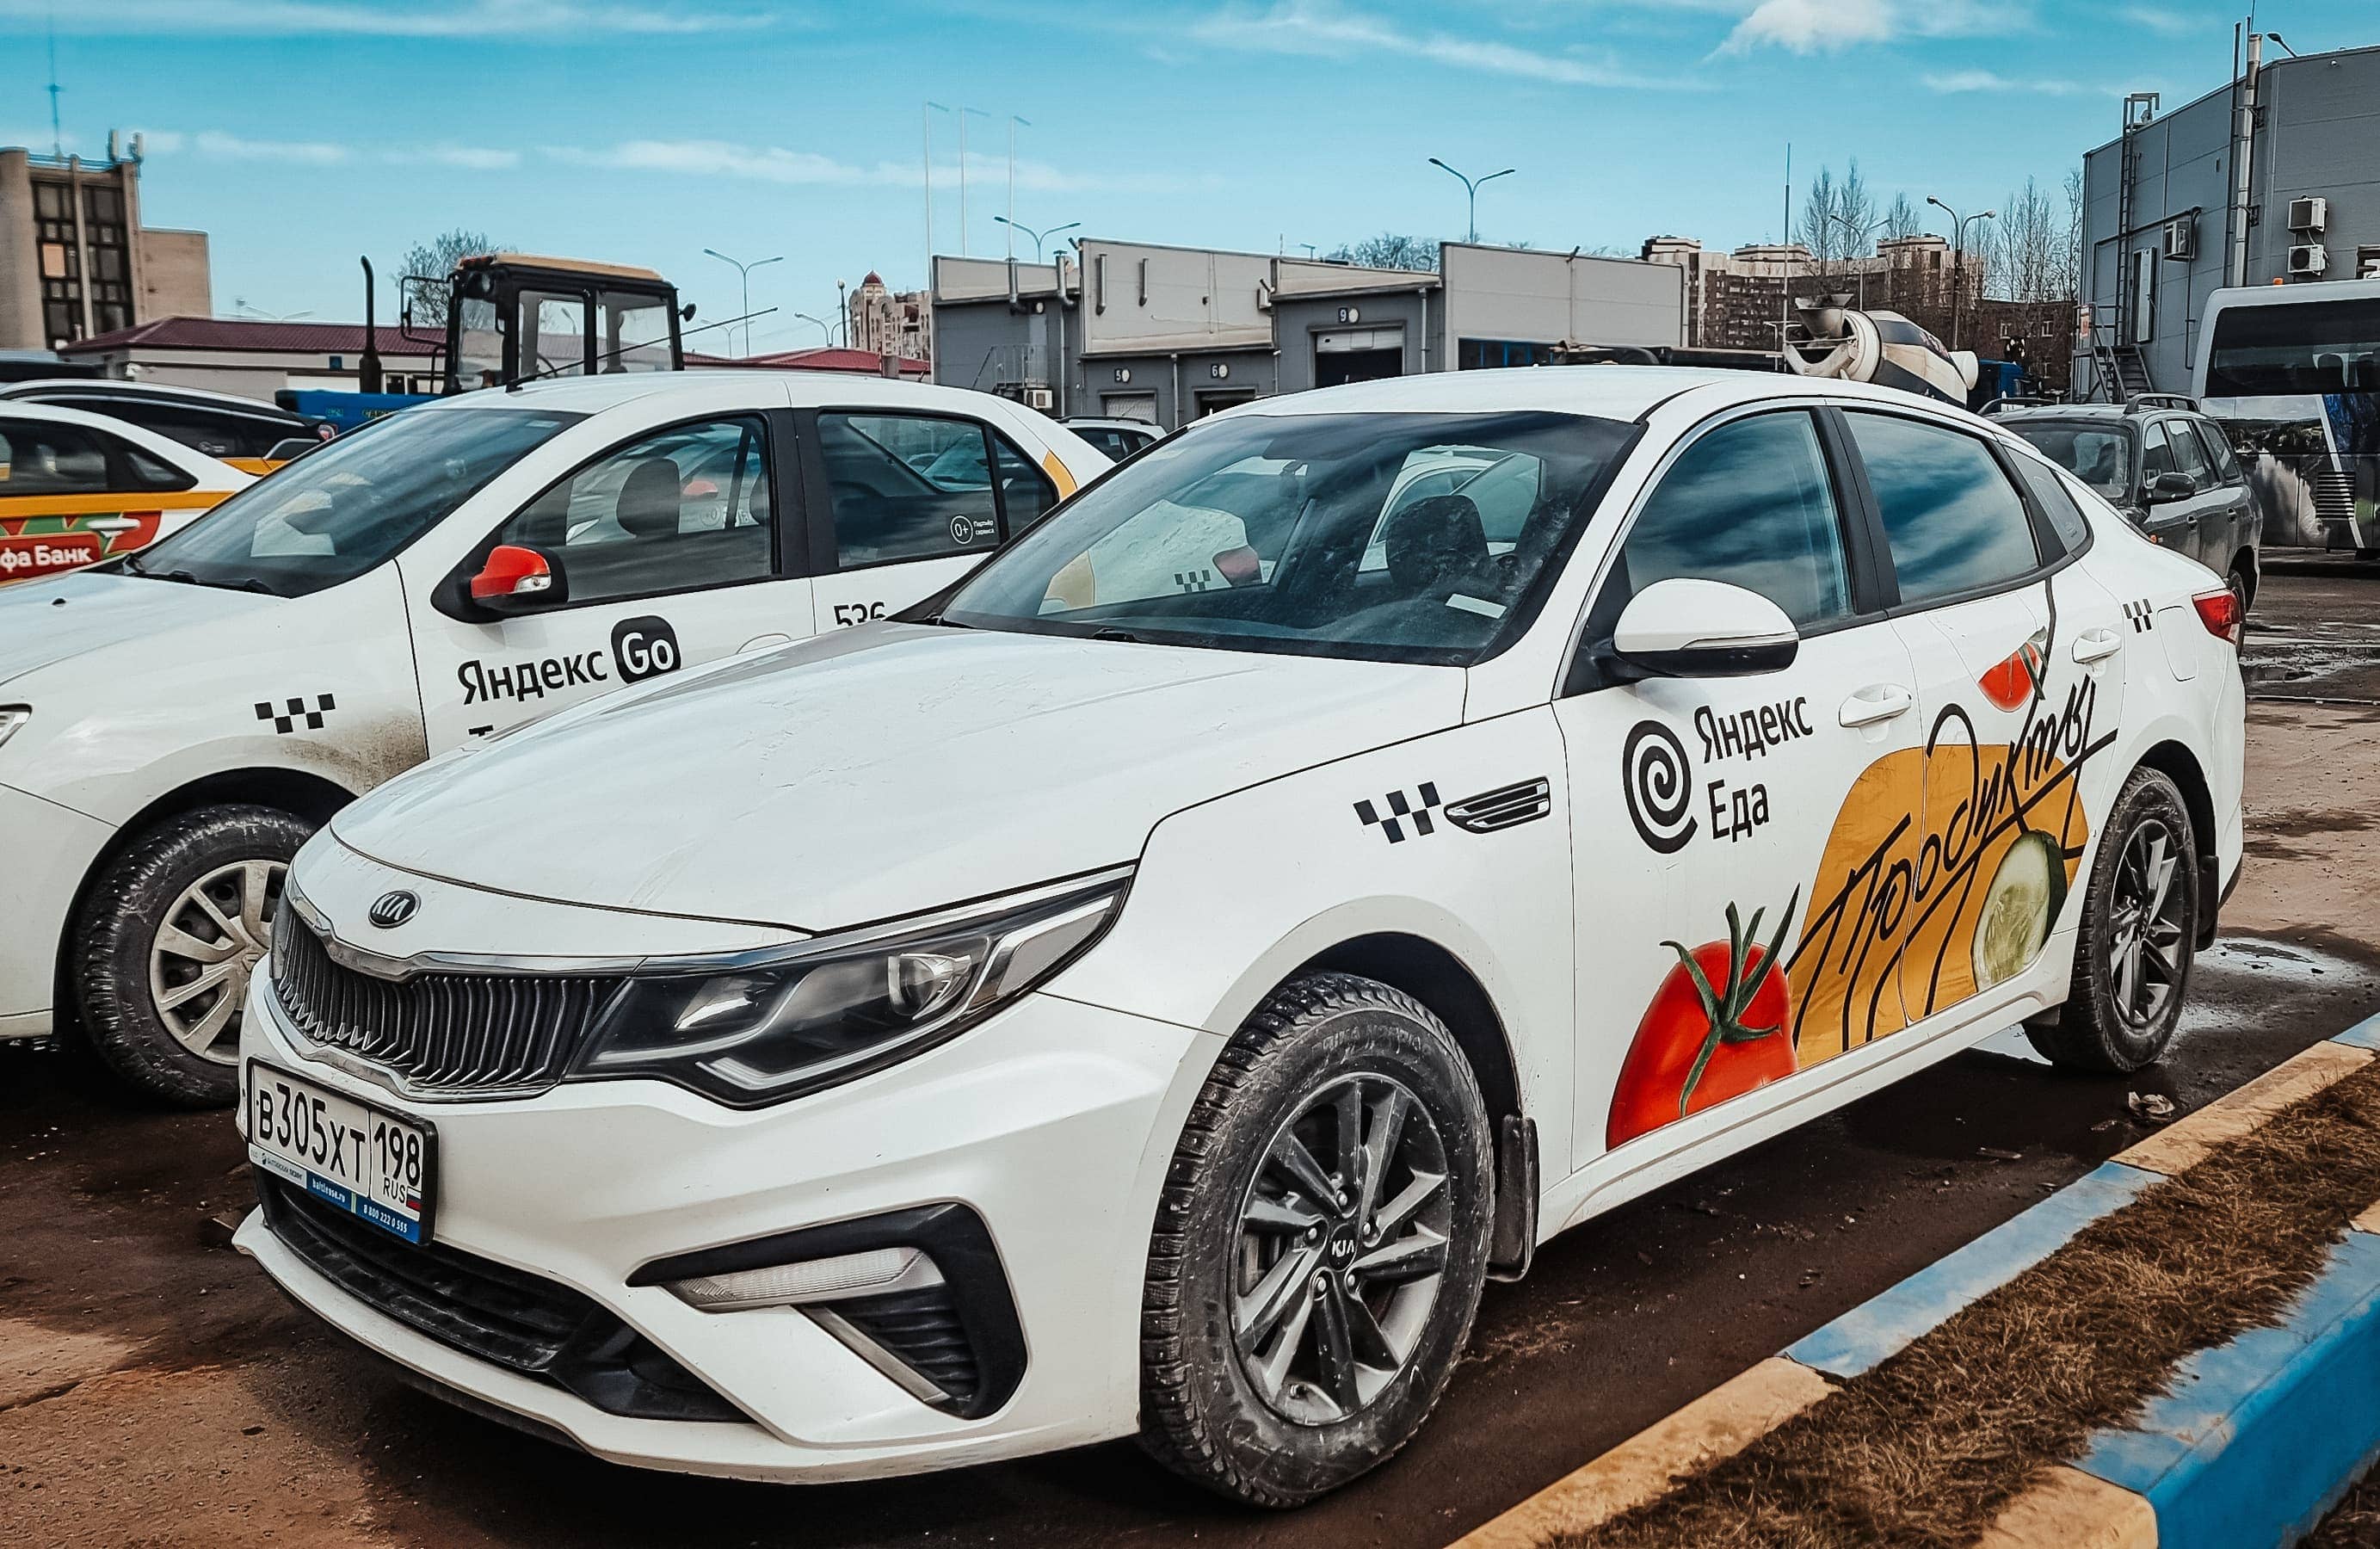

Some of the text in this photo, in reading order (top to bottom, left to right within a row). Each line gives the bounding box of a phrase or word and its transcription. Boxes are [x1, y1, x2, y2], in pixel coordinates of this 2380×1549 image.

[1340, 309, 1347, 322] 9
[1116, 370, 1122, 381] 5
[1212, 365, 1218, 376] 6
[954, 523, 969, 537] 0+
[34, 545, 95, 567] Банк
[457, 632, 675, 706] Яндекс Go
[1693, 694, 1815, 765] Яндекс
[1709, 779, 1771, 843] Еда
[1784, 675, 2118, 1052] Продукты
[371, 893, 410, 921] KIA
[259, 1081, 422, 1187] В305ХТ 198
[382, 1180, 406, 1205] RUS
[379, 1212, 392, 1225] 222
[396, 1218, 408, 1233] 555
[1331, 1241, 1354, 1256] KIA
